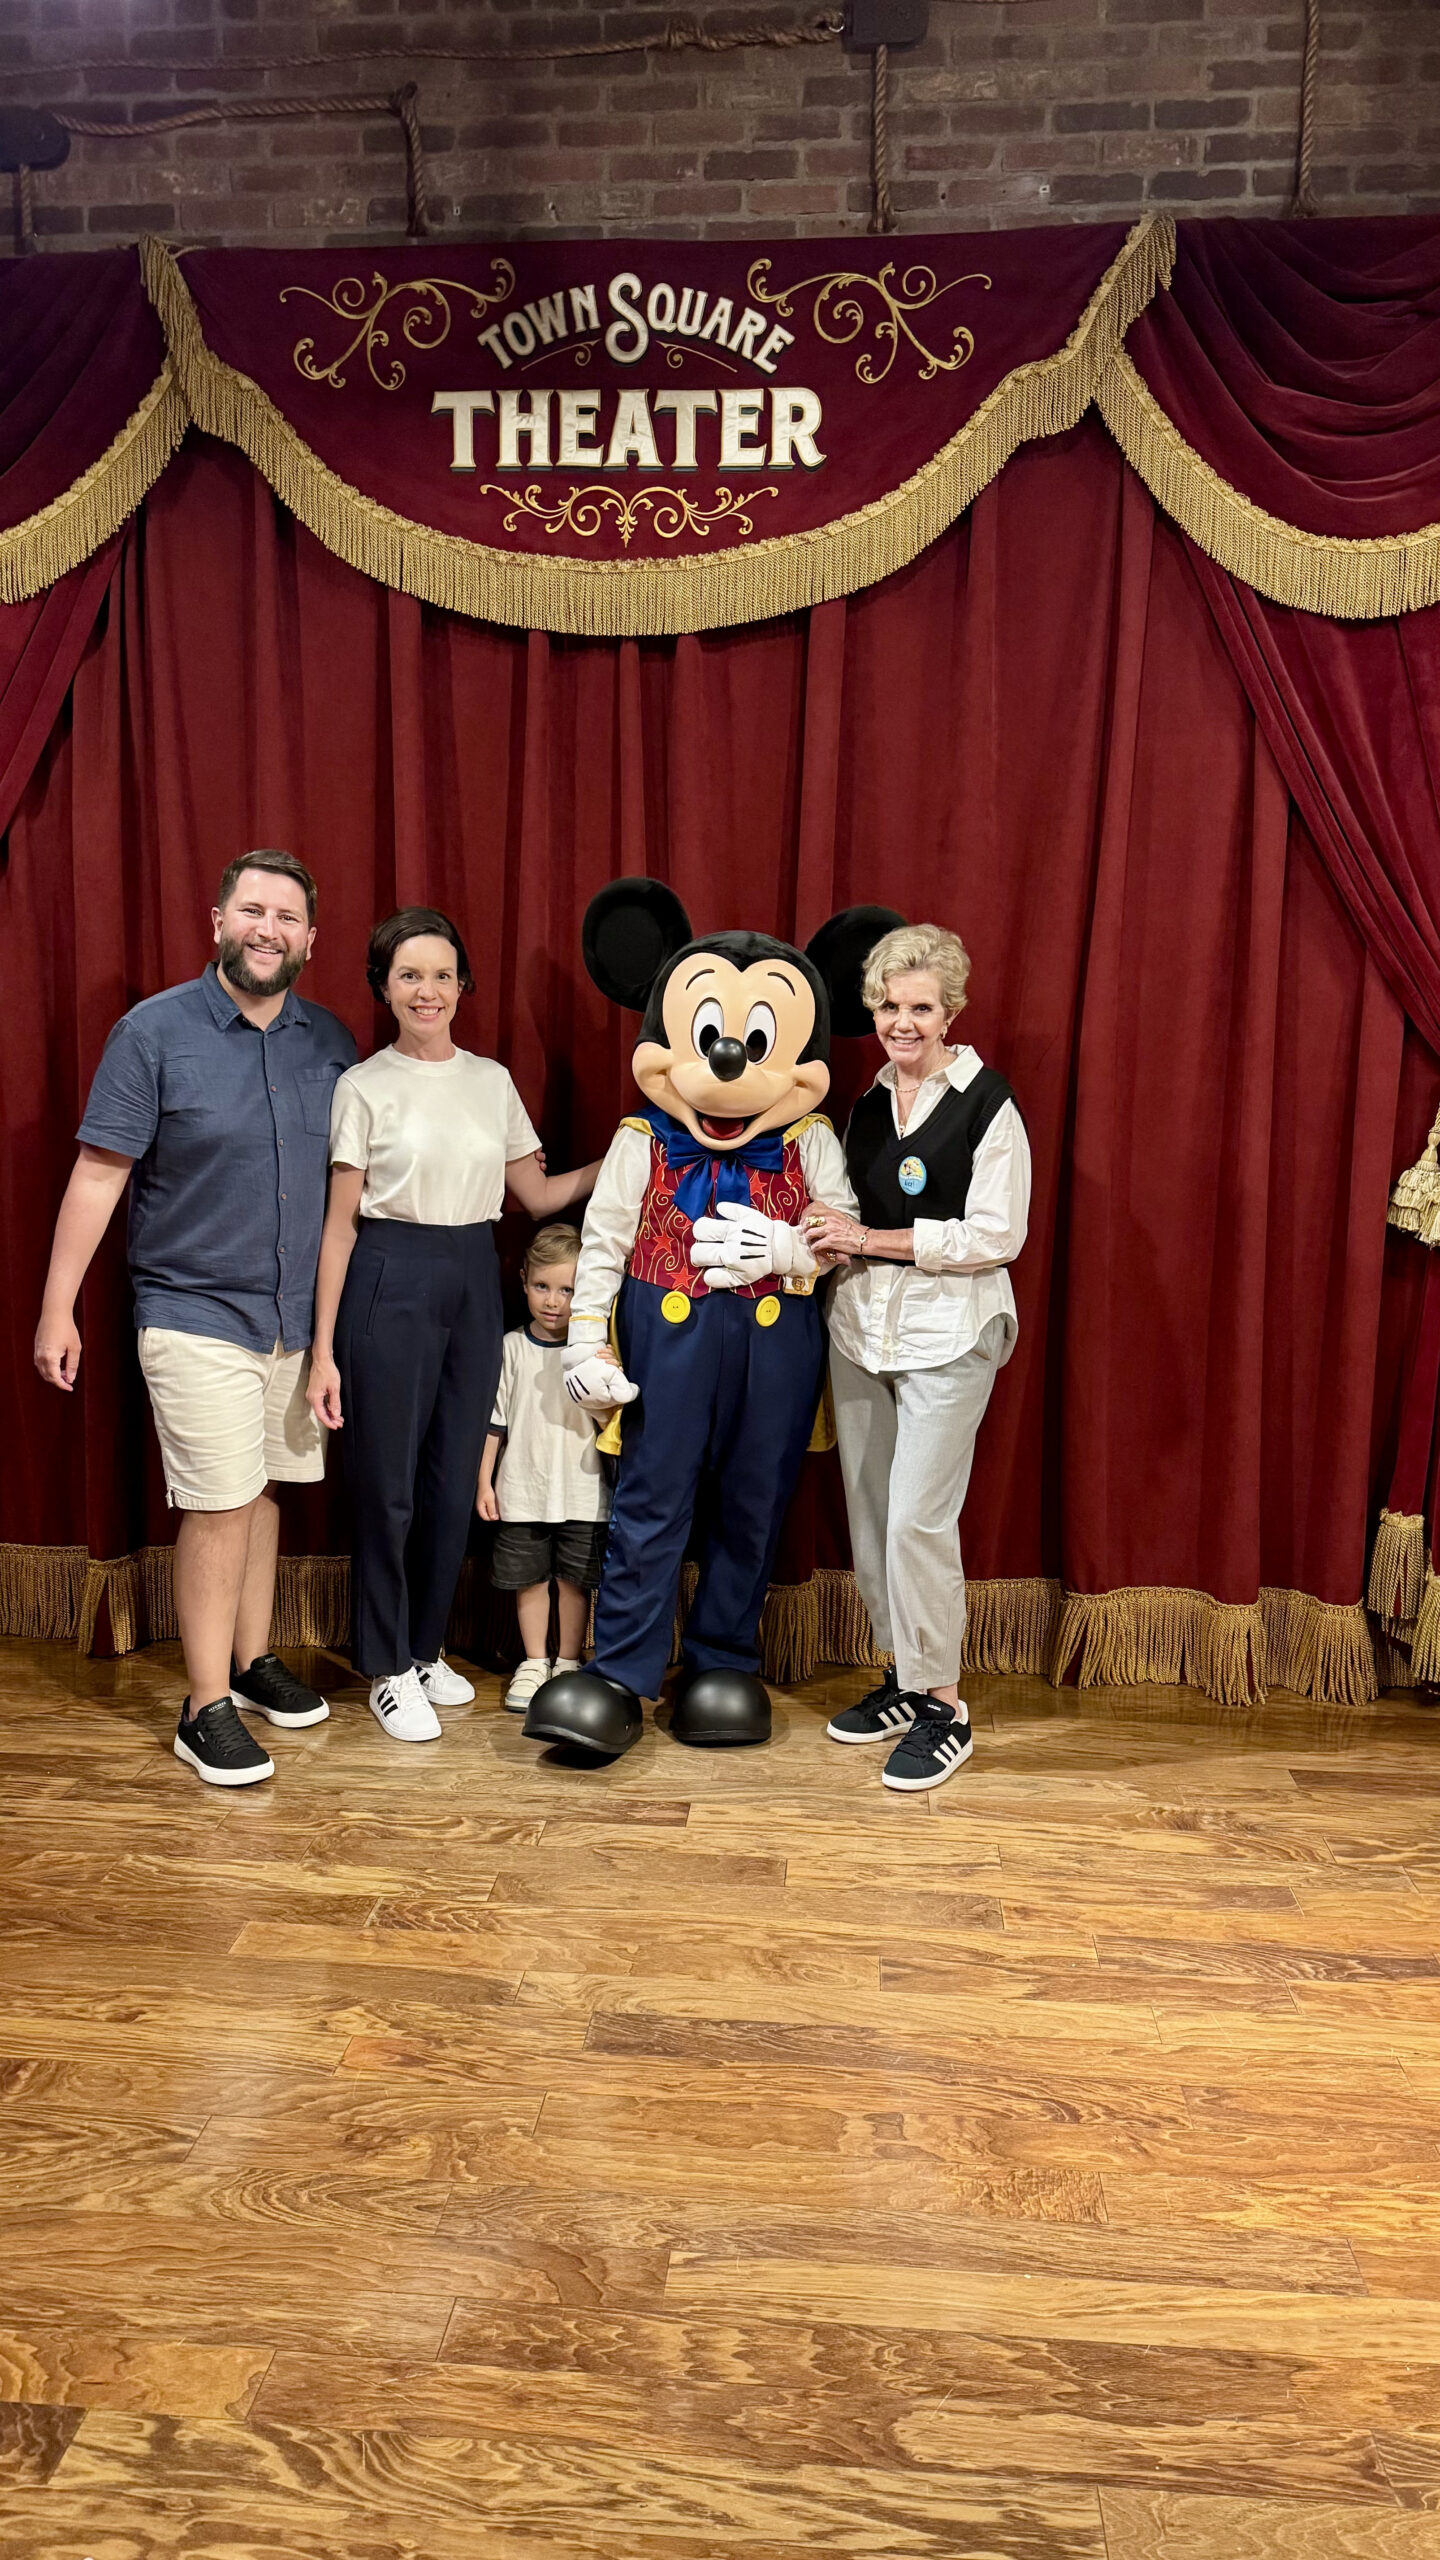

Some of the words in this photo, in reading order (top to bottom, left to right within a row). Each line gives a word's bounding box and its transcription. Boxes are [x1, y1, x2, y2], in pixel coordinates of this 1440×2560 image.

[477, 284, 600, 369] TOWN
[605, 272, 796, 374] SQUARE
[431, 387, 827, 470] THEATER
